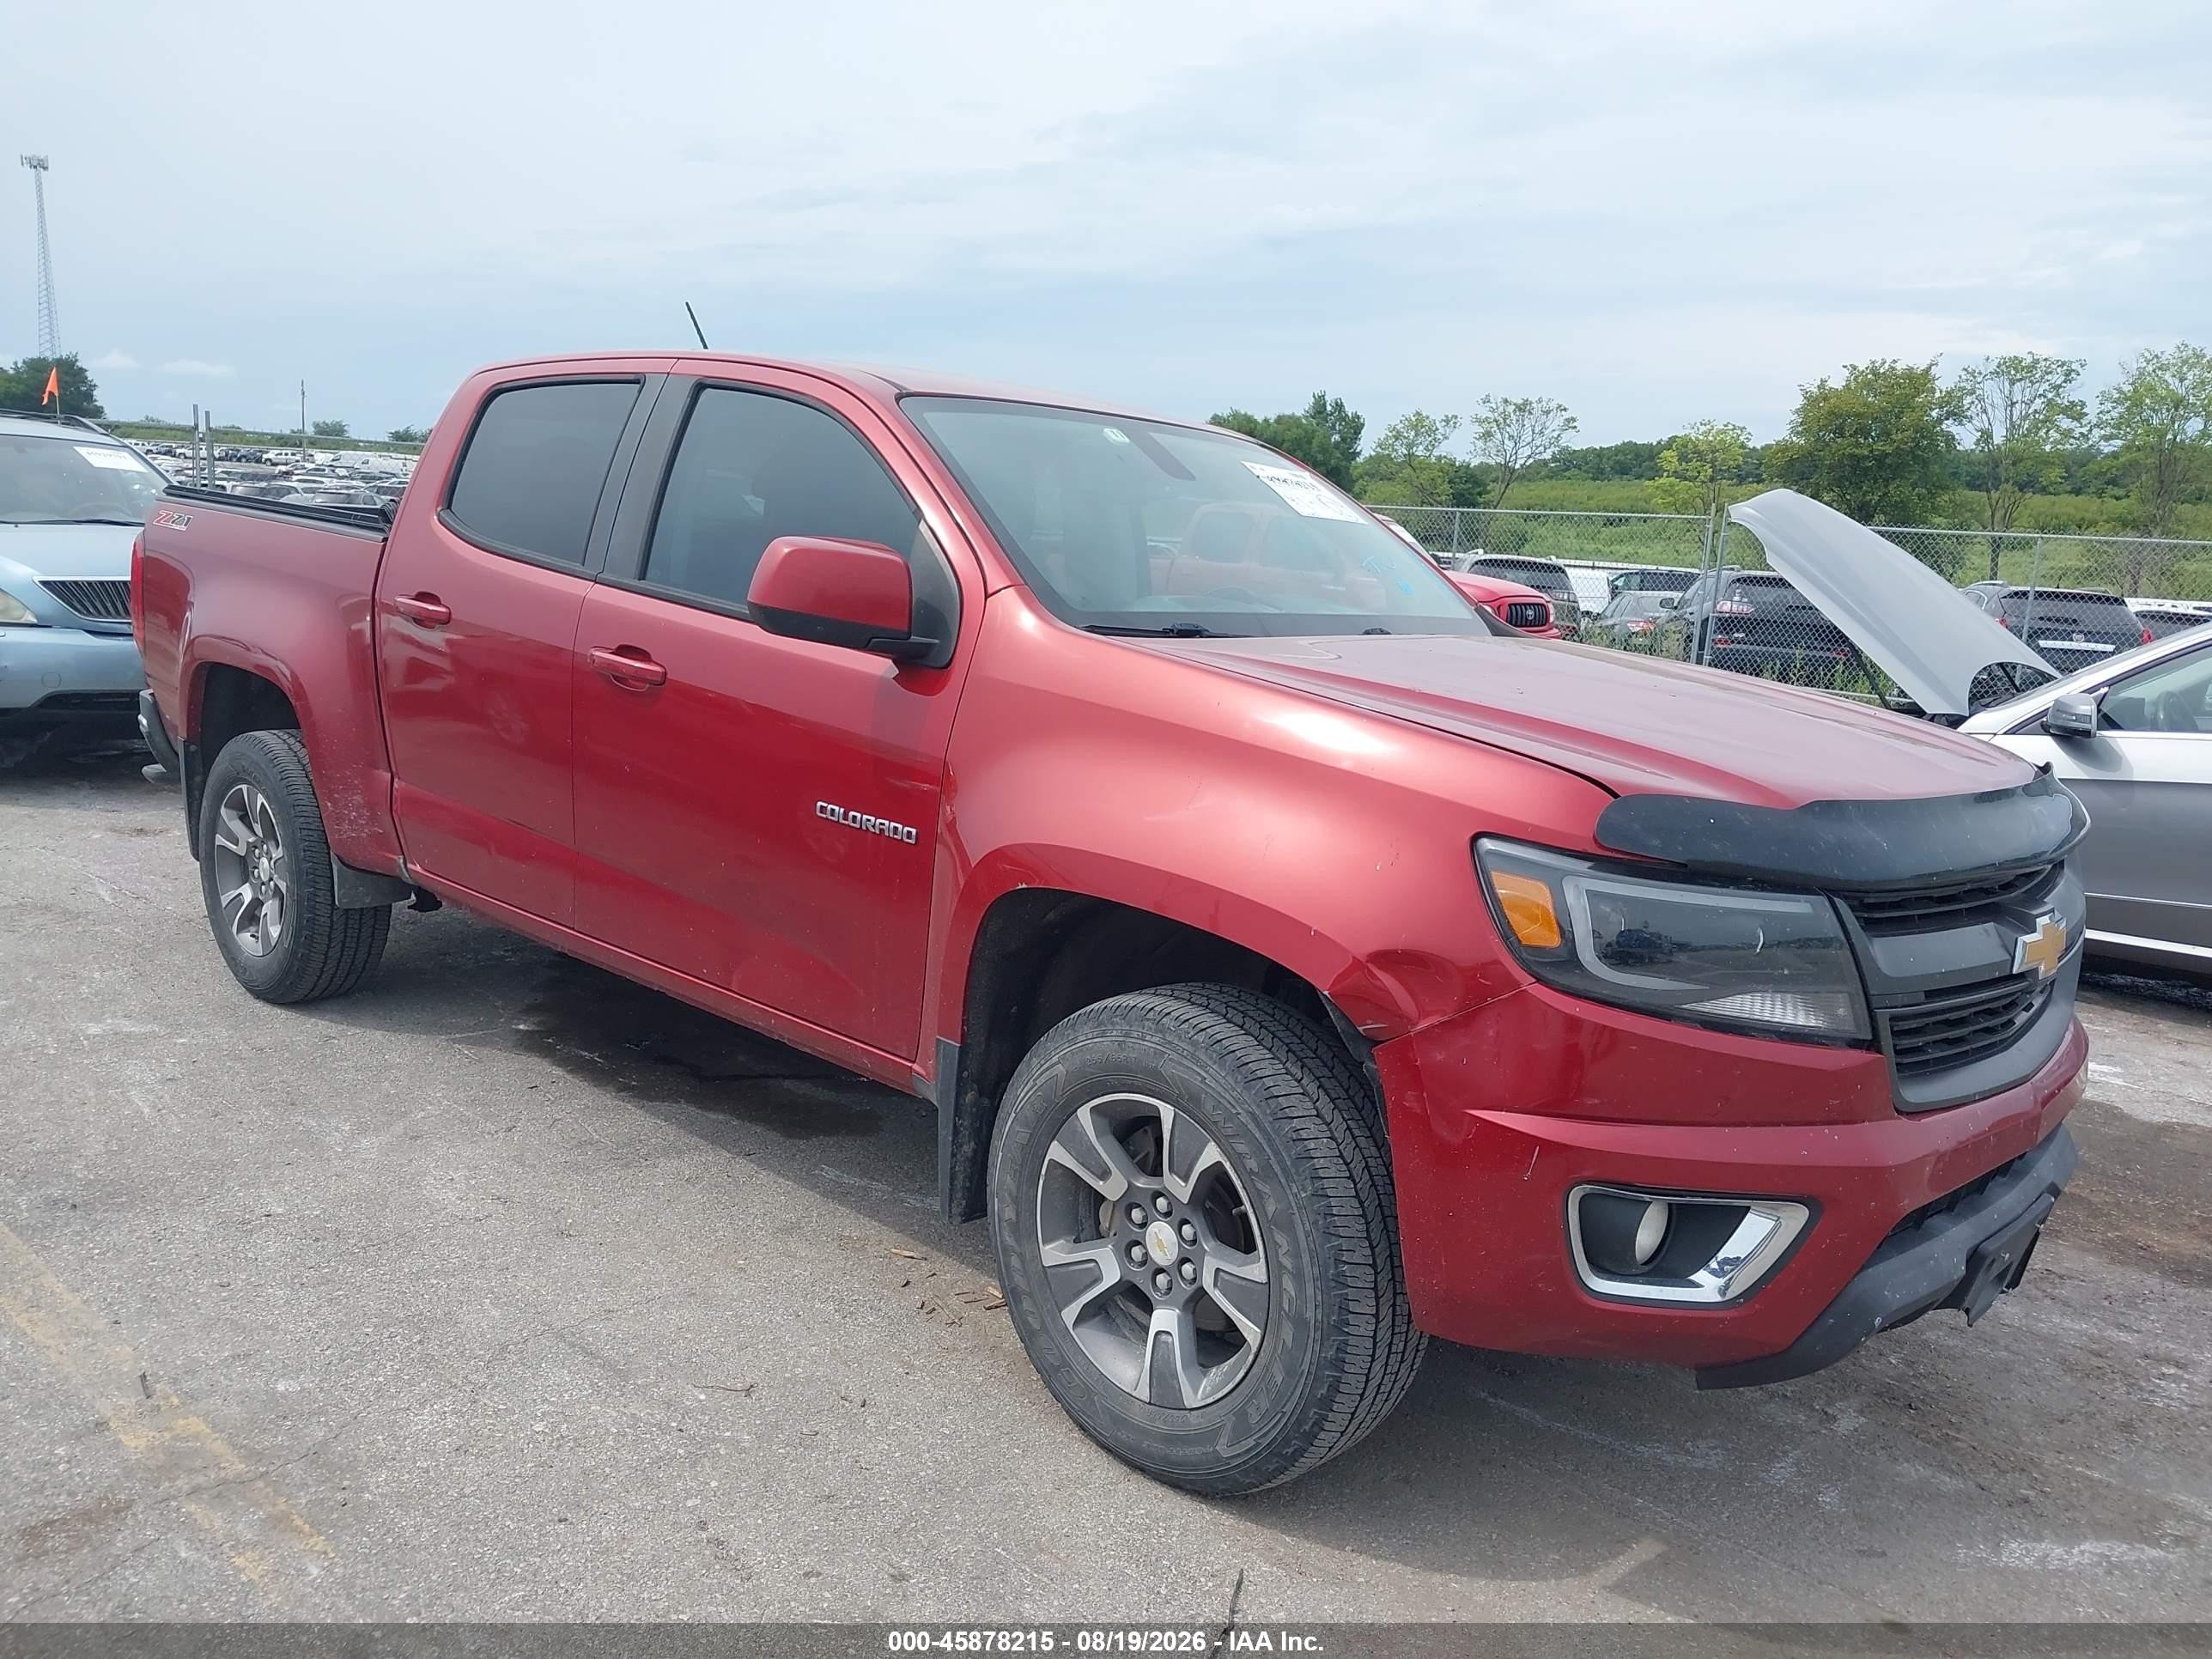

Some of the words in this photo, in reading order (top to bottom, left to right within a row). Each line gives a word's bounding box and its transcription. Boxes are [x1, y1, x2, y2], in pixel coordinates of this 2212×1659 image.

[153, 510, 194, 530] Z71
[816, 800, 917, 844] COLORADO
[1206, 1099, 1297, 1425] WRANGLER
